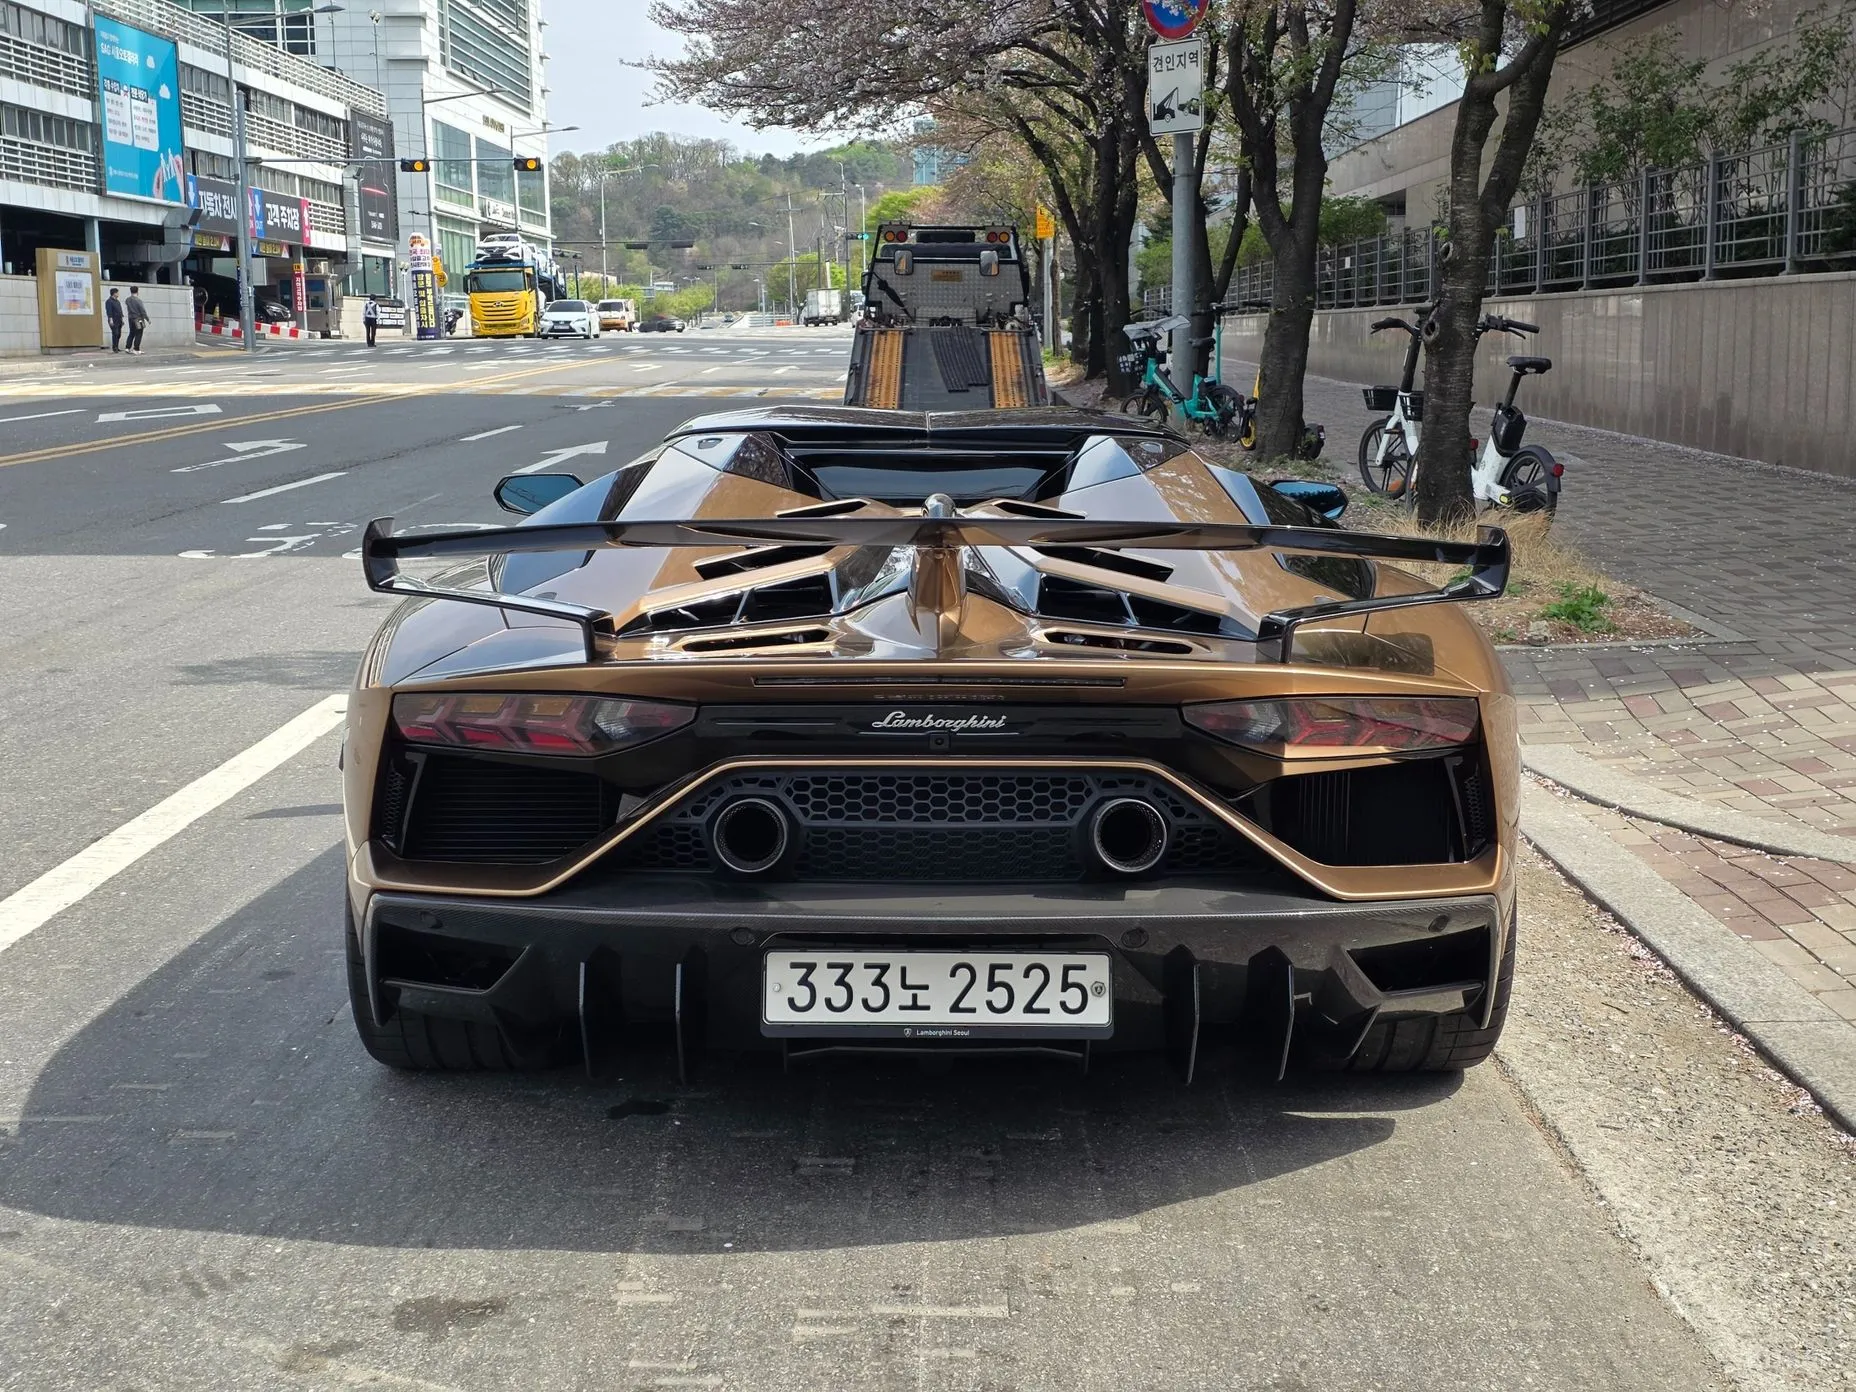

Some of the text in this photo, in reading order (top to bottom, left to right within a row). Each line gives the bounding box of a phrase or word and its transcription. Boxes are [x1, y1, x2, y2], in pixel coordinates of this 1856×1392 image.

[1153, 50, 1199, 73] 견인지역
[199, 191, 238, 220] 자동차 전시
[266, 203, 299, 231] 고객 주차장
[872, 710, 1007, 732] Lamborghini
[787, 961, 1089, 1015] 333노 2525
[916, 1029, 953, 1037] Lamborghini
